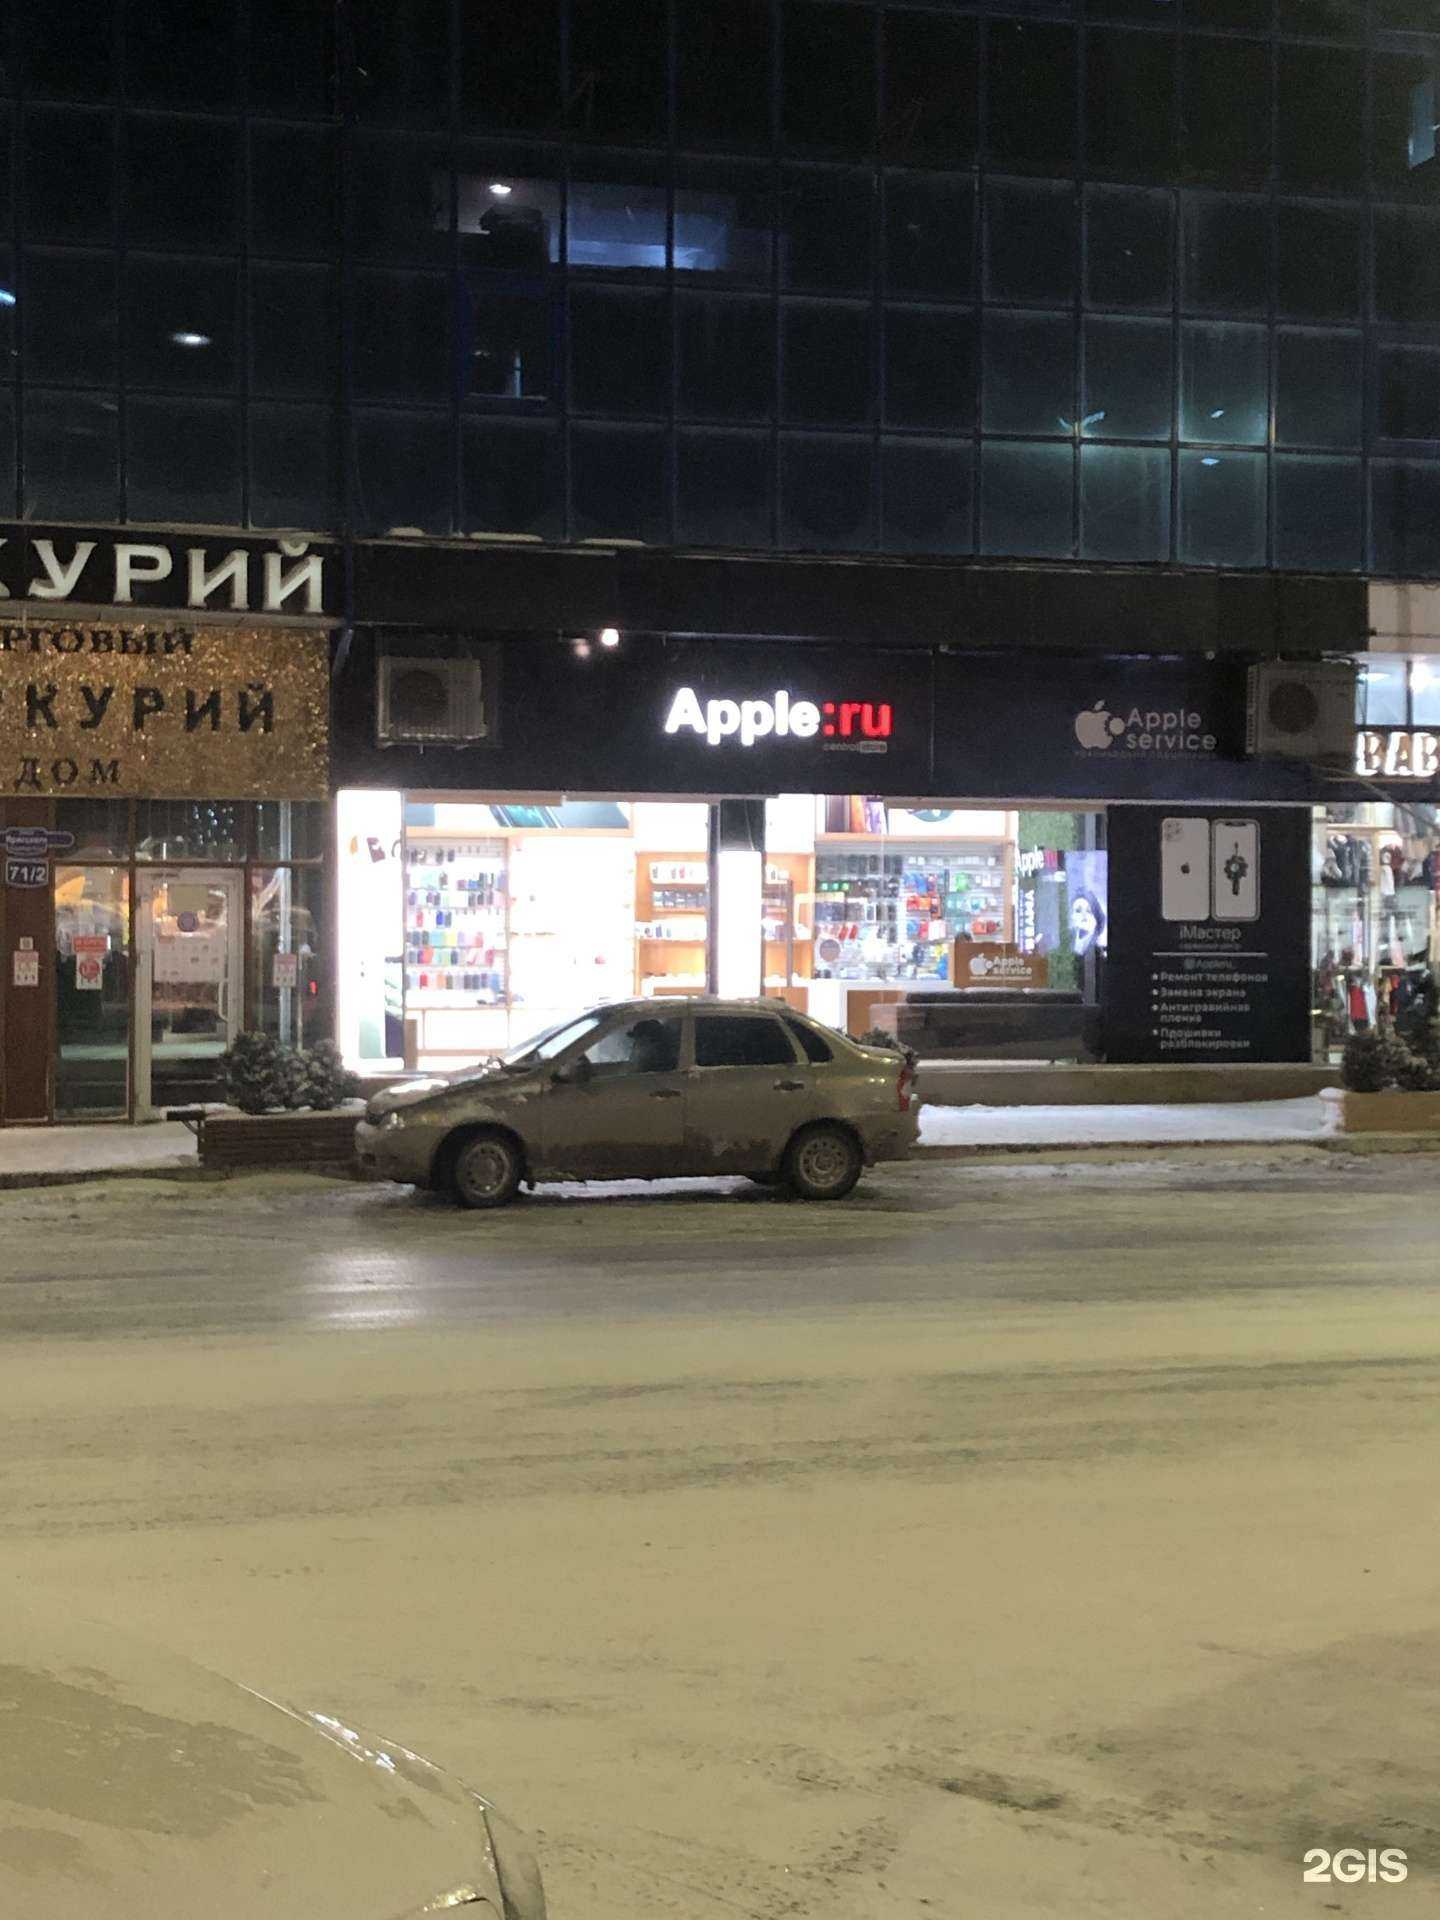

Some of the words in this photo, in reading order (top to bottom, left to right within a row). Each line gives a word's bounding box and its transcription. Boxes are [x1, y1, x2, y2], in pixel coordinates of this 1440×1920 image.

[1126, 707, 1201, 732] Apple
[1126, 732, 1217, 750] service
[15, 757, 121, 791] ДОМ
[9, 866, 46, 882] 71/2
[1160, 972, 1203, 982] Ремонт
